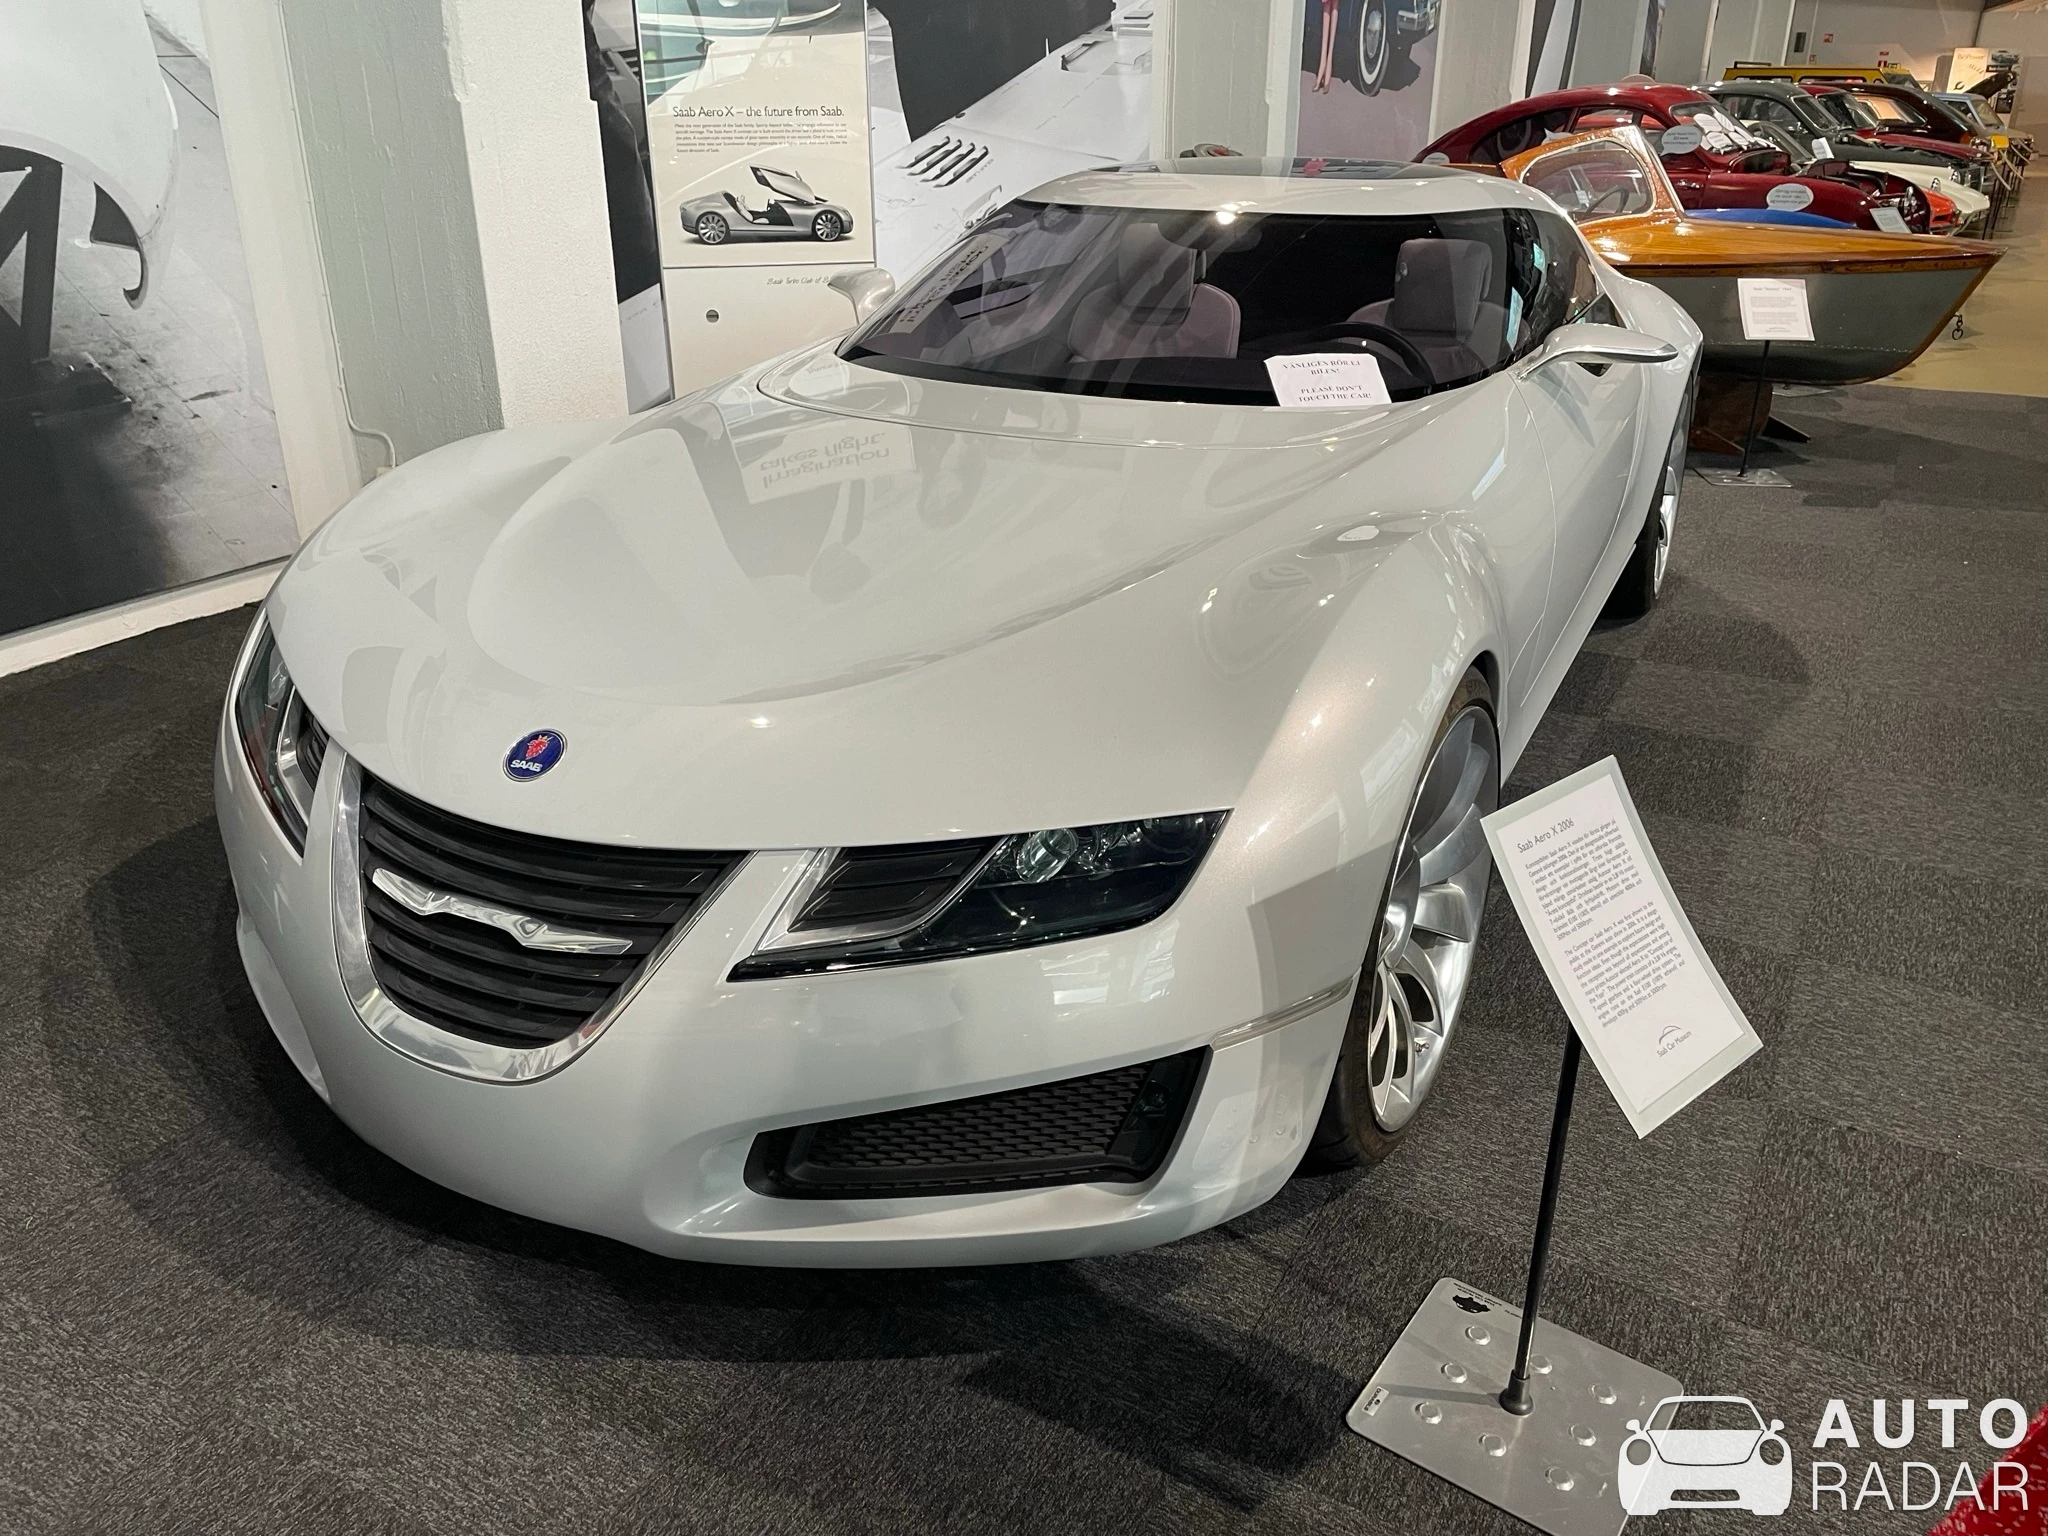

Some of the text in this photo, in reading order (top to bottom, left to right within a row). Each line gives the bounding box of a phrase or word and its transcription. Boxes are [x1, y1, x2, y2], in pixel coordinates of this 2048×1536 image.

[673, 106, 696, 117] Saab
[698, 107, 723, 117] Aero
[725, 106, 734, 117] X
[746, 106, 762, 117] the
[764, 106, 793, 117] future
[795, 106, 818, 117] from
[820, 106, 845, 117] Saab.
[1282, 361, 1328, 370] VÄNLIGEN
[1311, 368, 1340, 376] BILEN!
[1301, 386, 1335, 394] PLEASE
[510, 760, 543, 772] SAAB
[1517, 817, 1575, 853] Saab Aero X 2006
[1656, 1031, 1692, 1058] Saab Car Museum
